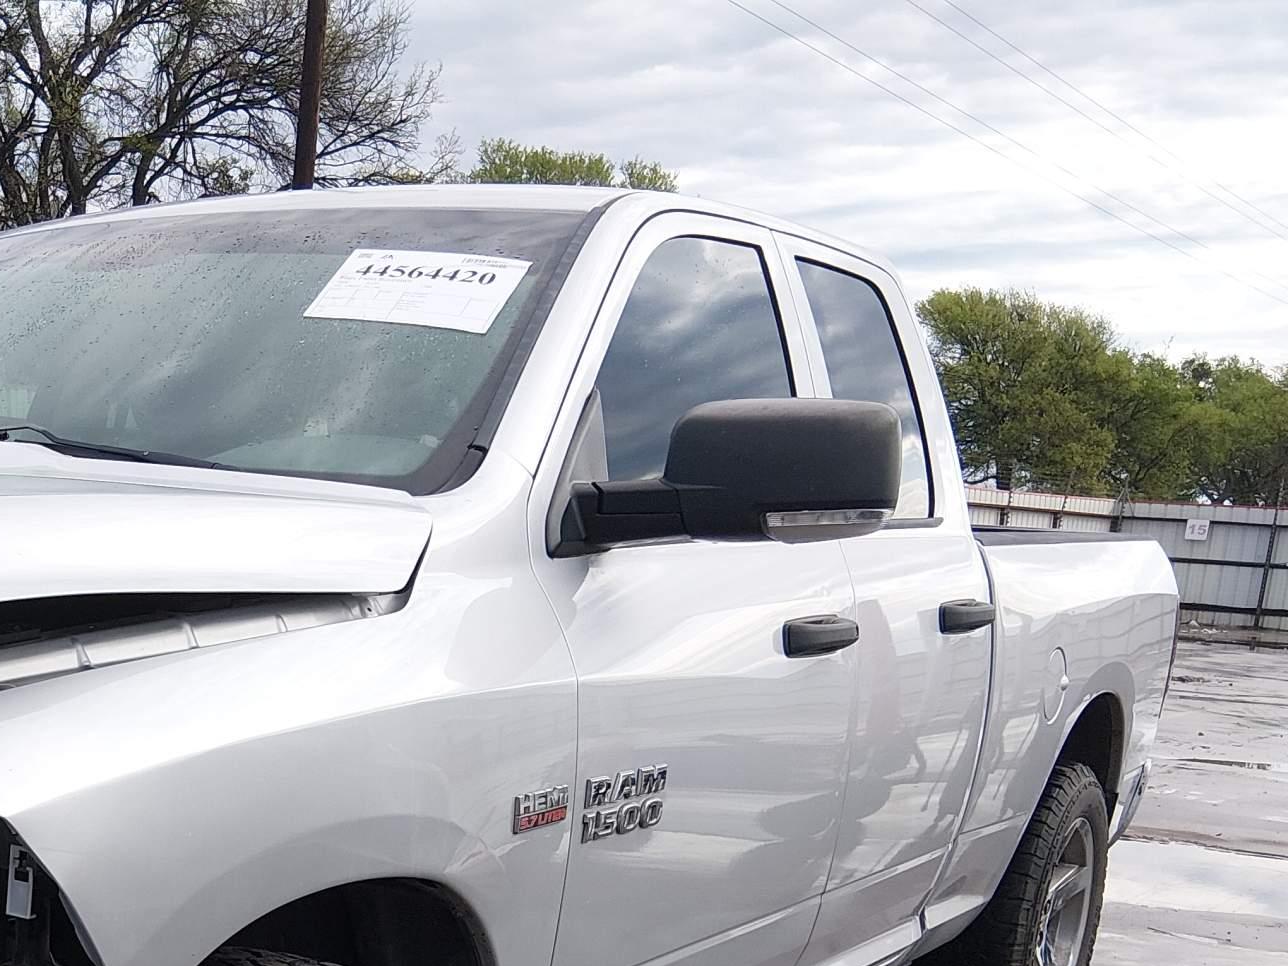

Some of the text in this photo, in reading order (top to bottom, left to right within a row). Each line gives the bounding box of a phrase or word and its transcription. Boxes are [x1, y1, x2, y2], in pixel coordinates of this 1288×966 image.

[355, 263, 497, 286] 44564420
[1188, 524, 1207, 536] 15
[513, 784, 569, 816] HEMI
[584, 764, 668, 809] RAM
[519, 814, 538, 831] 5.7
[581, 797, 663, 843] 1500
